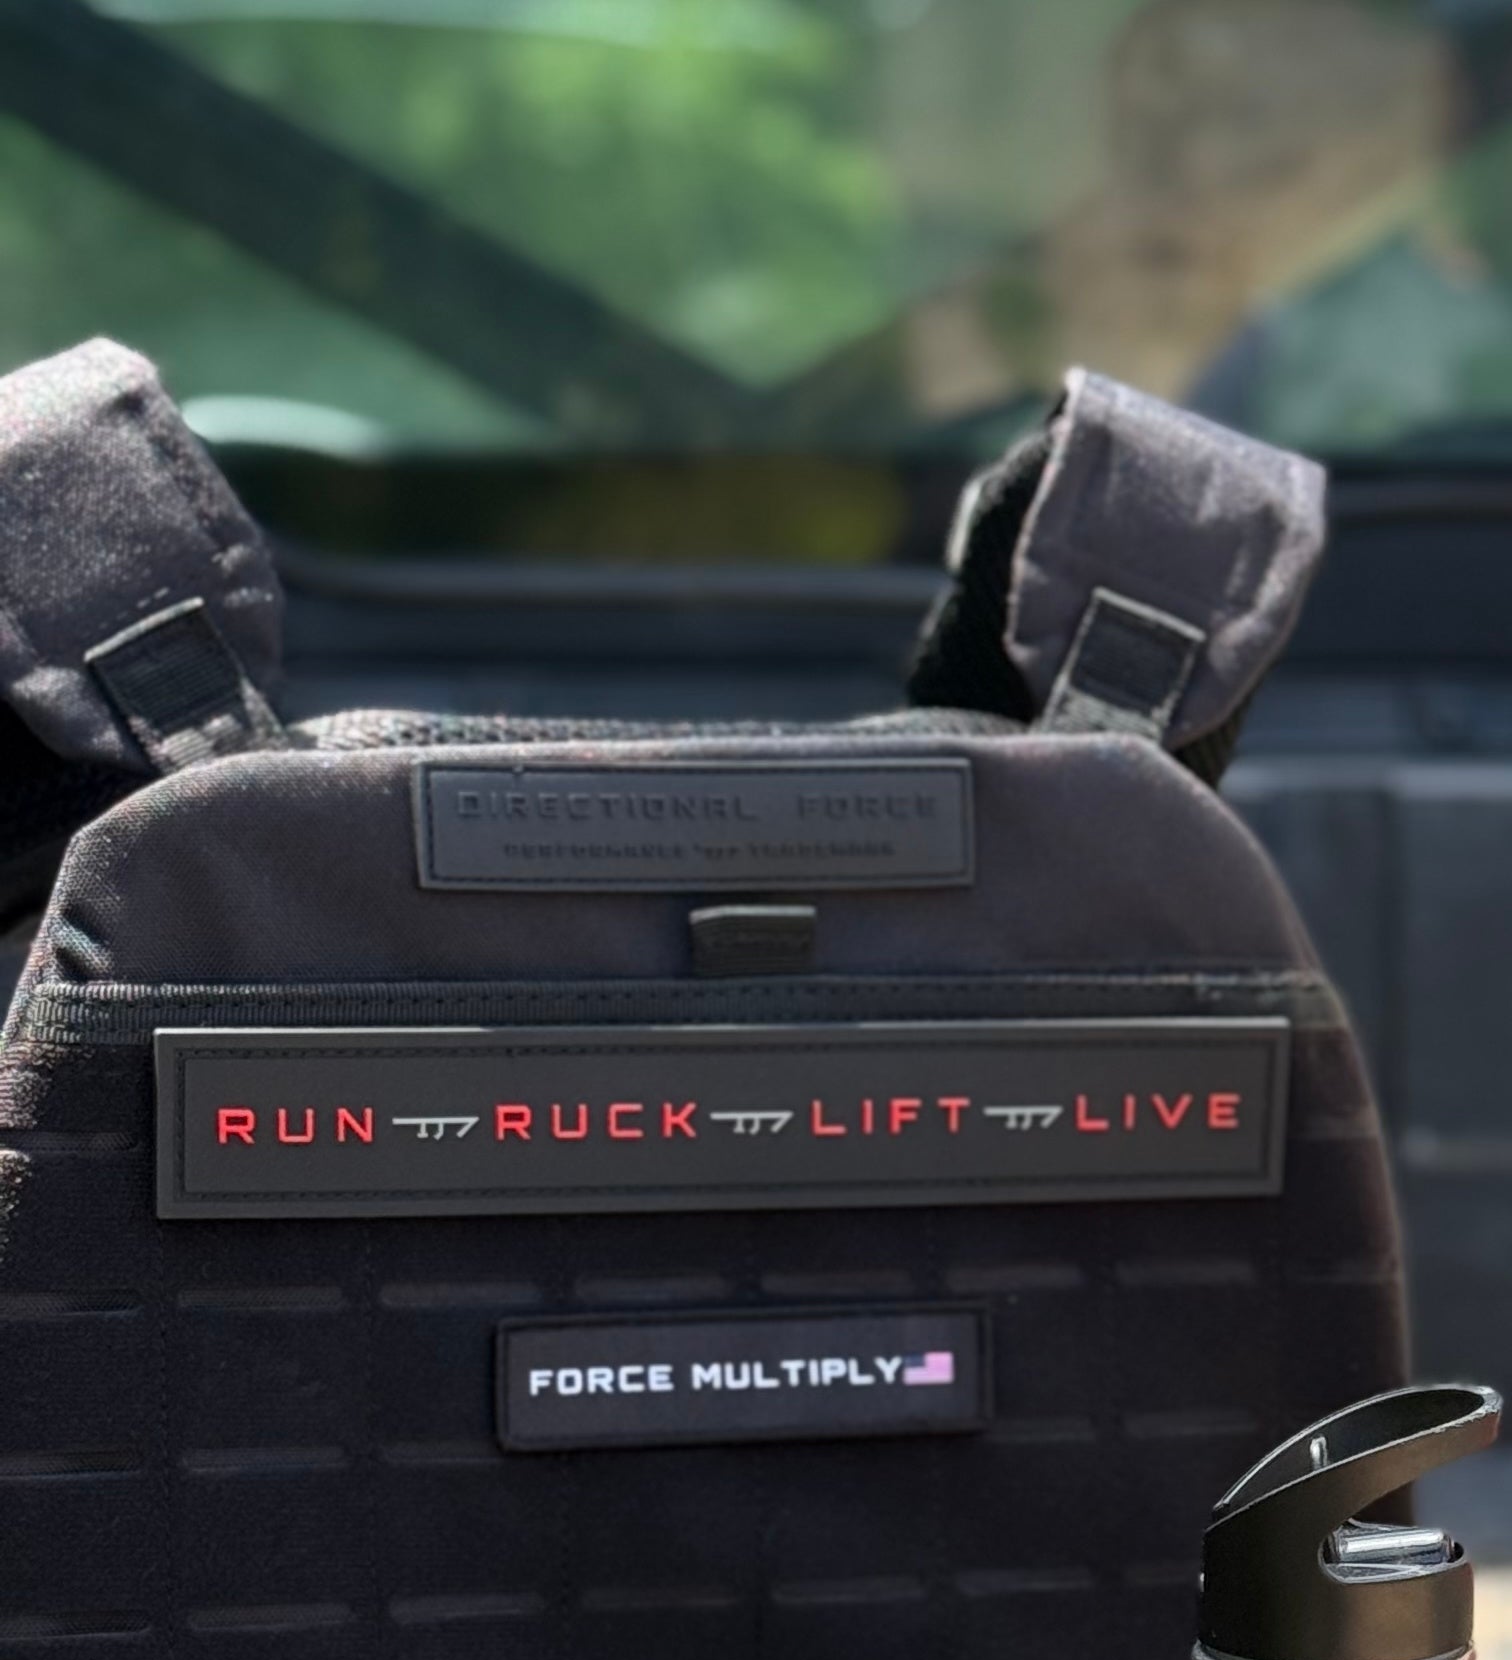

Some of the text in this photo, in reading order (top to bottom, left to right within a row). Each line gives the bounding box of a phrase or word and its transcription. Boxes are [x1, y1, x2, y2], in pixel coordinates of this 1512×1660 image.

[457, 789, 936, 822] DIRECTIONAL FORCE
[216, 1093, 1240, 1144] RUN RUCK LIFT LIVE
[528, 1354, 902, 1396] FORCE MULTIPLY
